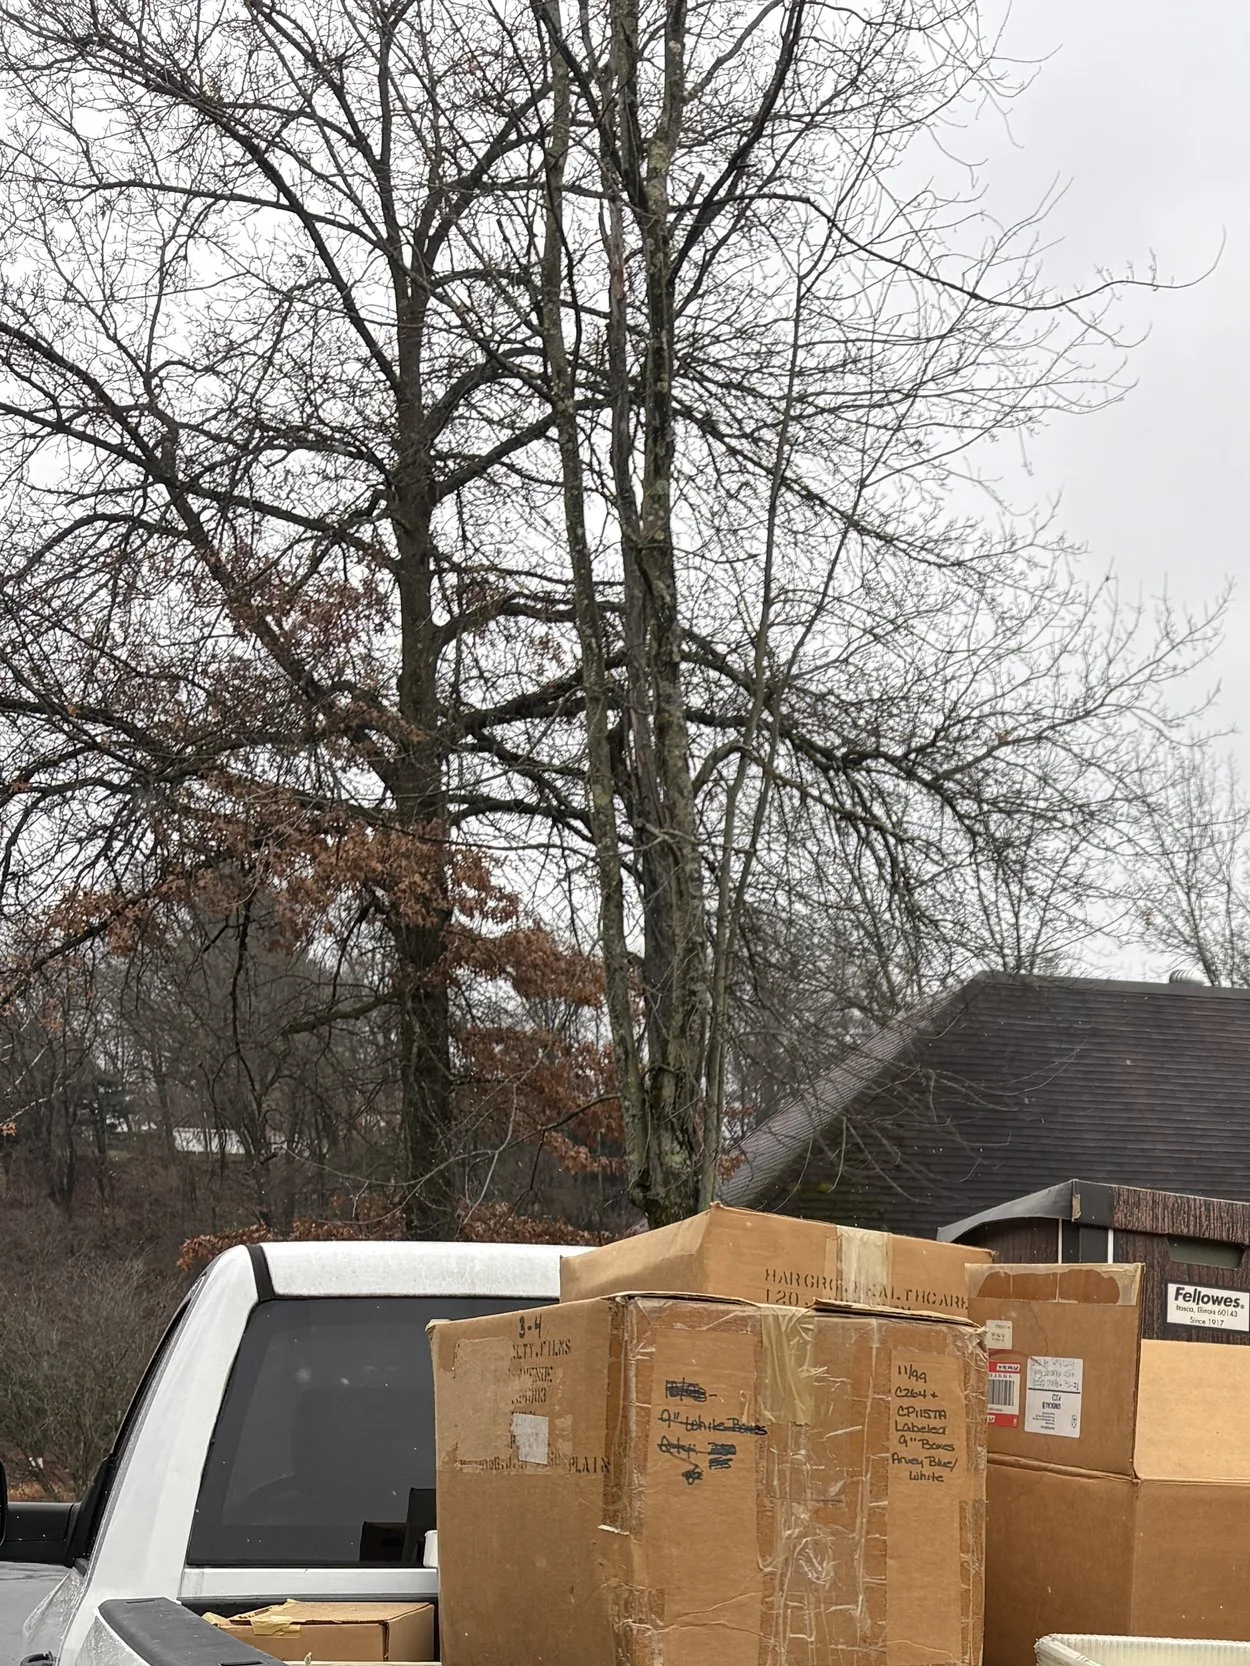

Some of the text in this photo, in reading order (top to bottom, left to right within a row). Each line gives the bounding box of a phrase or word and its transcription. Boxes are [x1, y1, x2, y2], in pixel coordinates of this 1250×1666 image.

[1174, 1287, 1241, 1309] Fellowes
[1217, 1309, 1238, 1318] 60143
[1190, 1317, 1224, 1327] Since 1917
[898, 1364, 927, 1383] 11/99
[895, 1420, 947, 1435] Labeled
[909, 1471, 944, 1482] White
